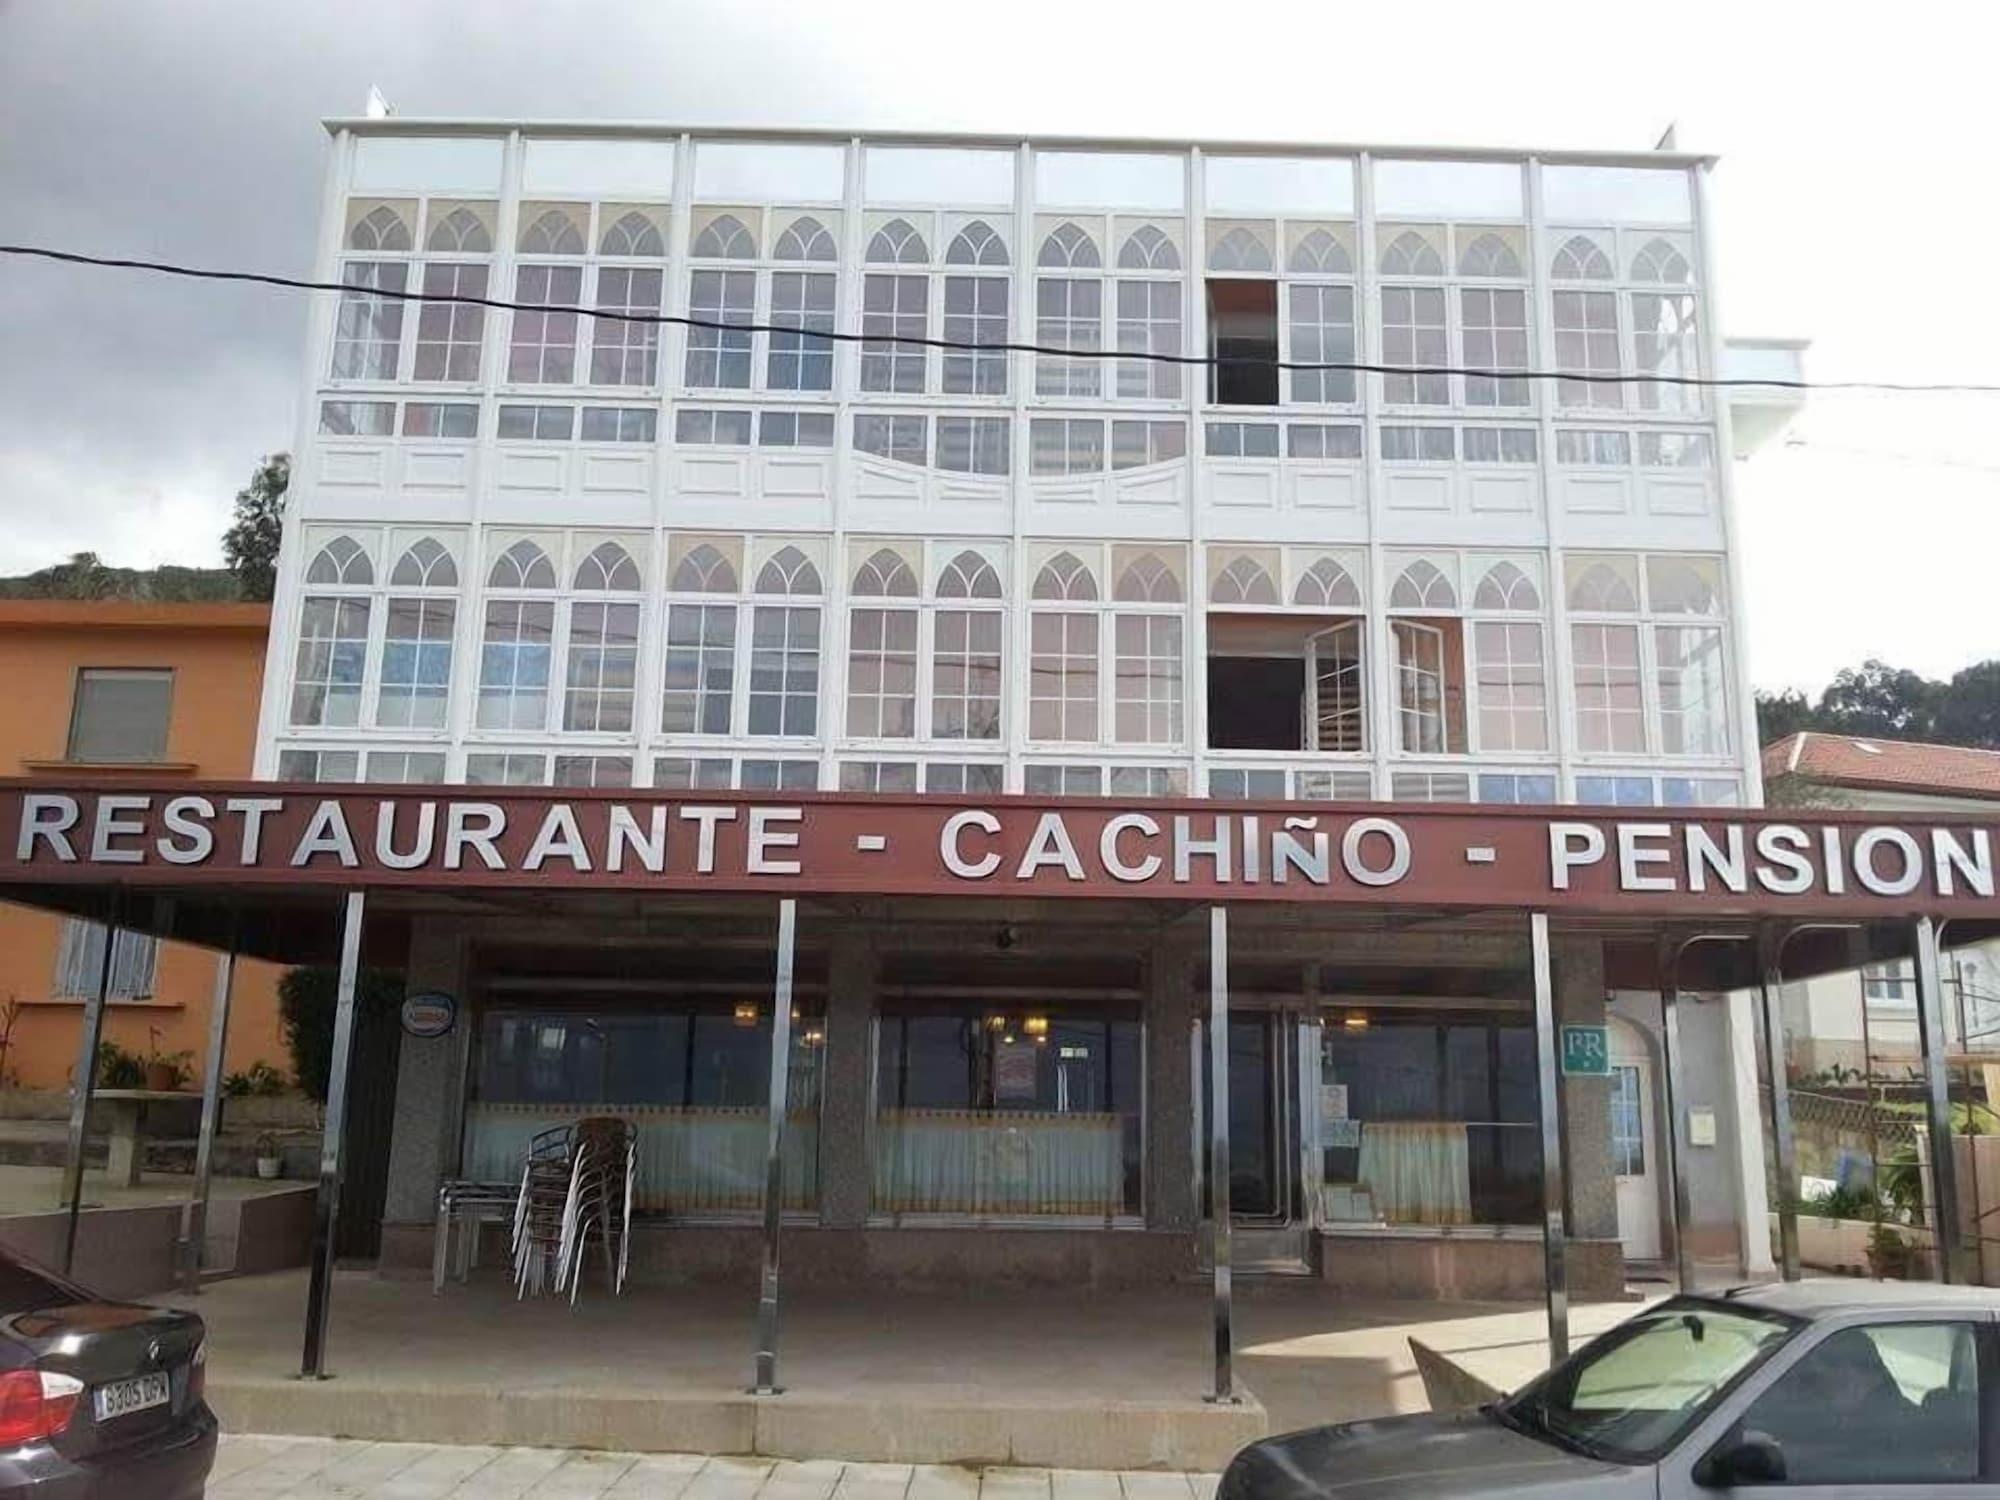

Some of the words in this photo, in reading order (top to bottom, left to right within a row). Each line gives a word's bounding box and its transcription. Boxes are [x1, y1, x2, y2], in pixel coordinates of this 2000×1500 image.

[16, 794, 803, 875] RESTAURANTE
[940, 811, 1412, 887] CACHIÑO
[1548, 821, 1996, 897] PENSION
